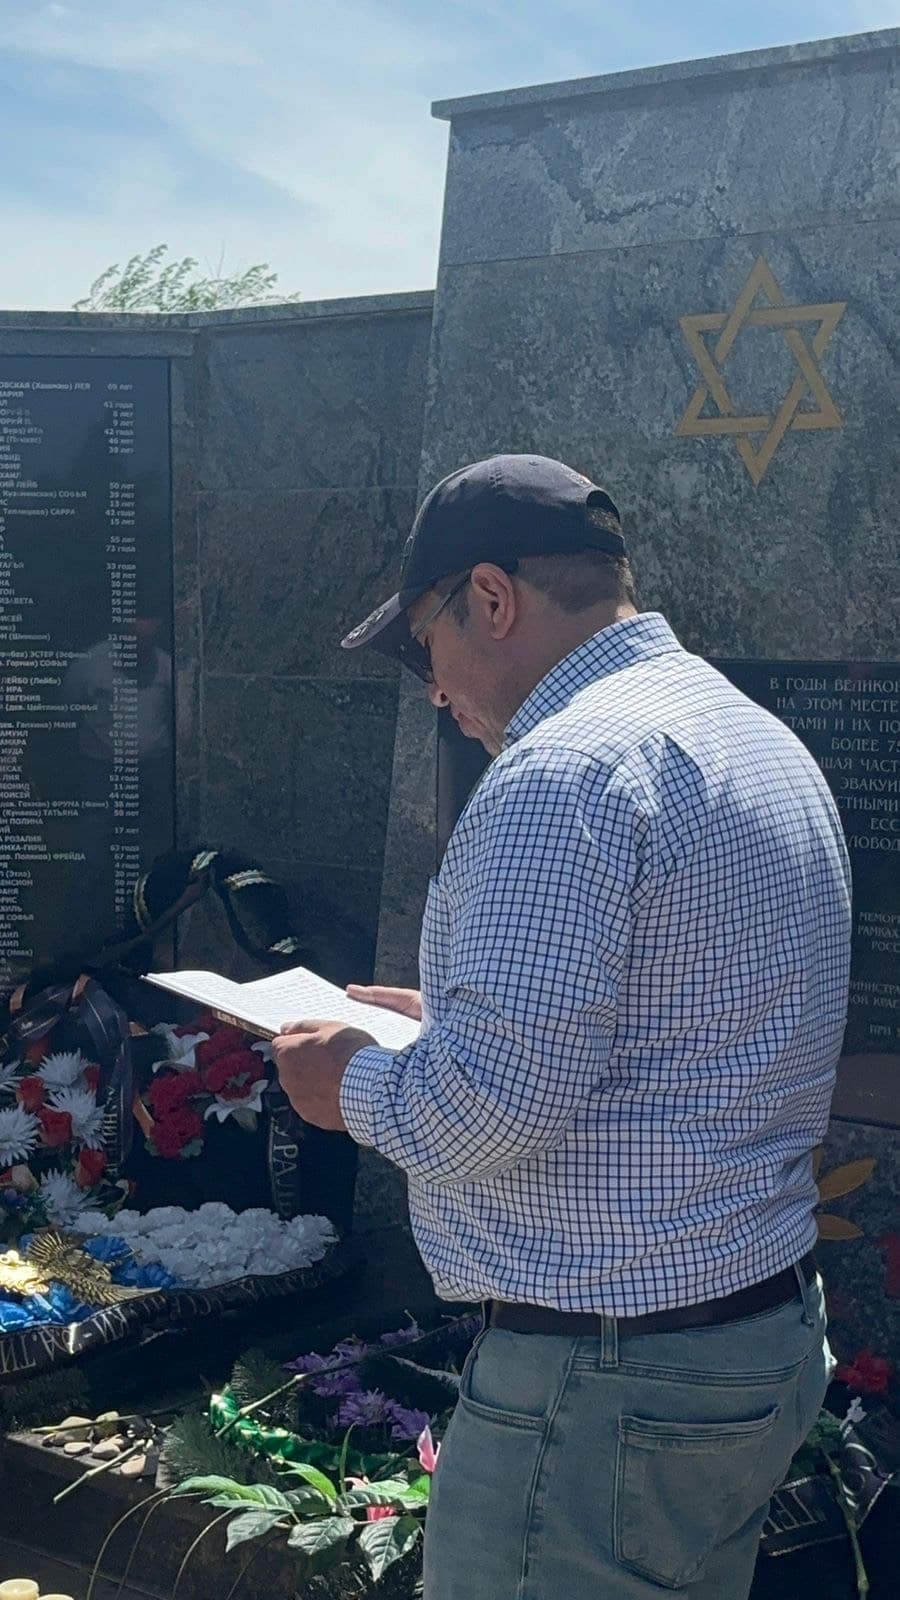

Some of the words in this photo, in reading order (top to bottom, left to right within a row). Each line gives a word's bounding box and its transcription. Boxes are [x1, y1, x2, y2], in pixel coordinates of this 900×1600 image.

[769, 677, 780, 691] В
[786, 678, 827, 691] ГОДЫ
[776, 696, 796, 709] НА
[802, 697, 843, 711] ЭТОМ
[850, 698, 899, 713] МЕСТЕ
[834, 718, 845, 731] И
[852, 718, 872, 732] ИХ
[879, 719, 900, 734] ПО
[831, 737, 880, 752] БОЛЕЕ
[820, 757, 853, 770] ШАЯ
[839, 776, 900, 792] ЭВАКУИ
[835, 796, 899, 812] СТНЫМИ
[870, 817, 900, 832] ЕСС
[848, 835, 900, 852] ЛОВОД
[859, 911, 900, 924] МЕМОР
